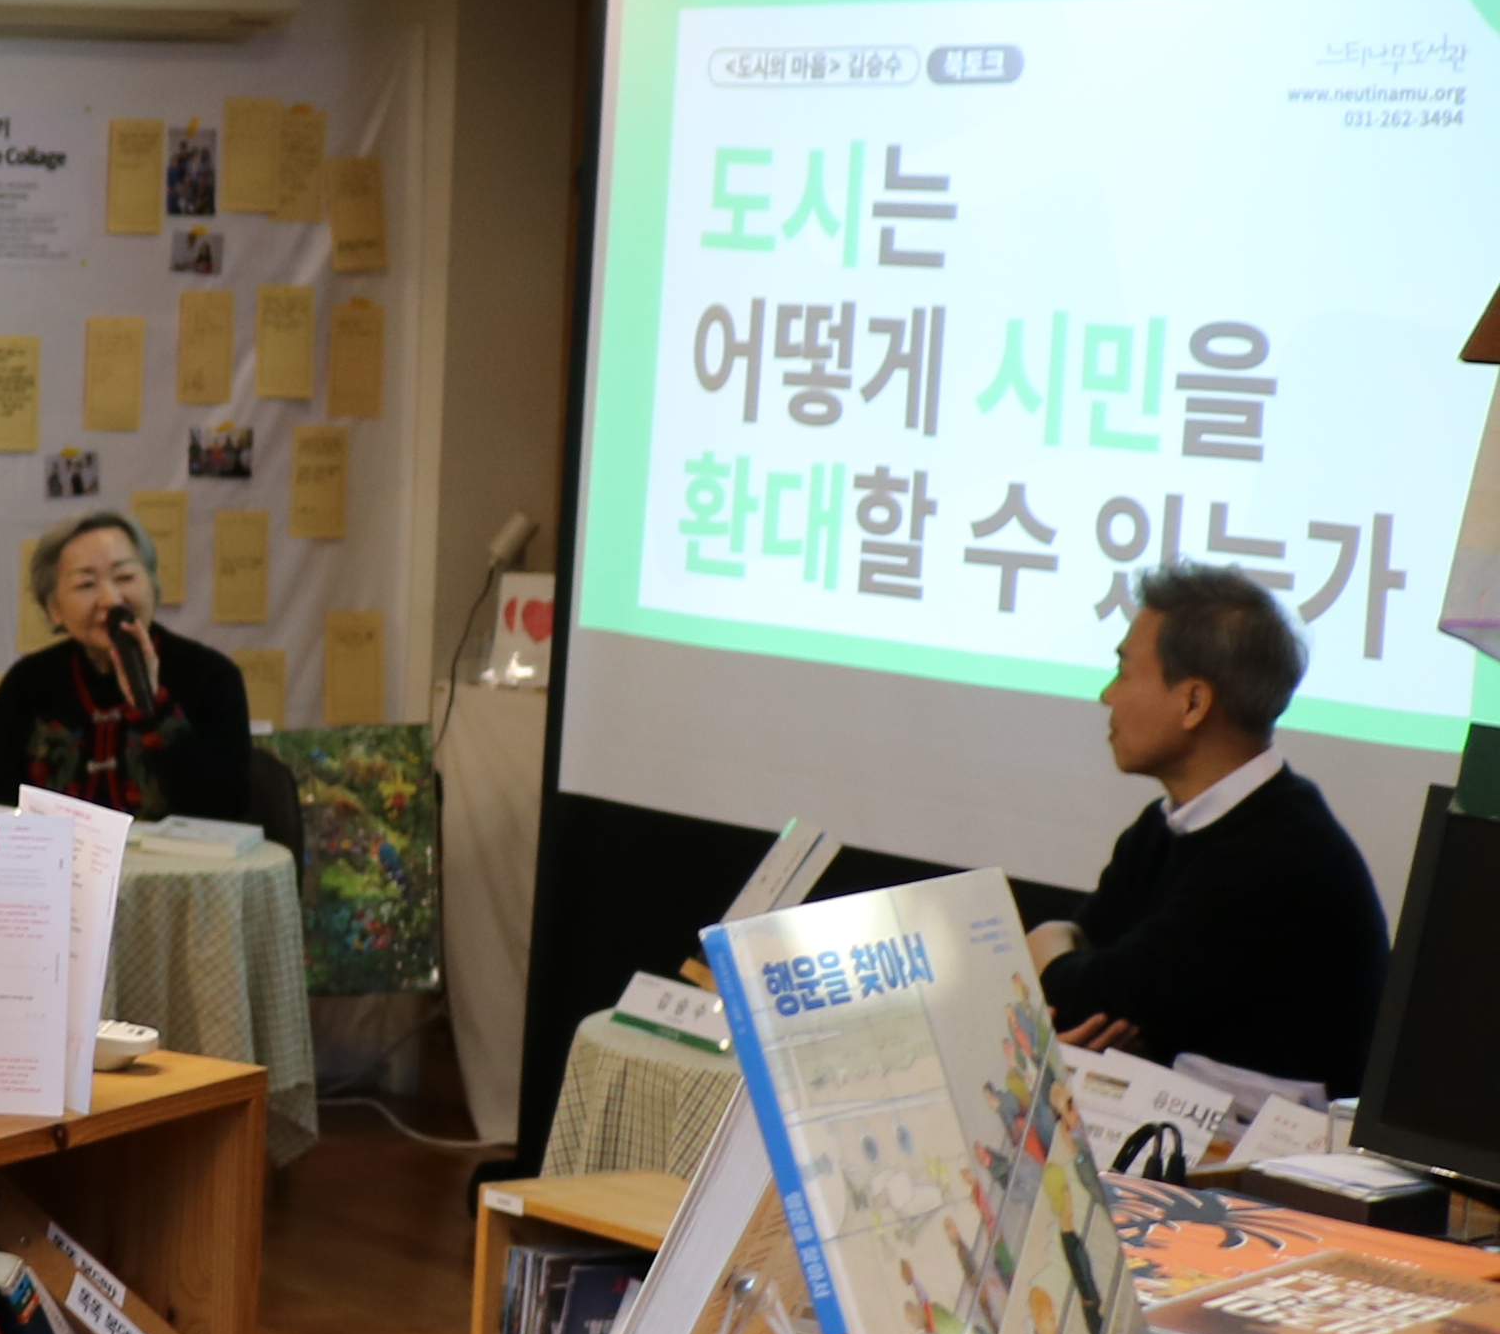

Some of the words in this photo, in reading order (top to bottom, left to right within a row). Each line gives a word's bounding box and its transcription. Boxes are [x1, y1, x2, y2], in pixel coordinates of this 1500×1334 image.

[1286, 83, 1467, 107] www.neutinamu.org
[1344, 108, 1465, 129] 031-262-3494
[5, 146, 69, 172] Collage
[698, 137, 960, 269] 도시는
[692, 297, 948, 439] 어떻게
[974, 308, 1279, 464] 시민을
[677, 450, 938, 603] 환대할
[962, 482, 1061, 615] 수
[762, 950, 853, 1017] 행운을
[850, 932, 936, 1000] 찾아서
